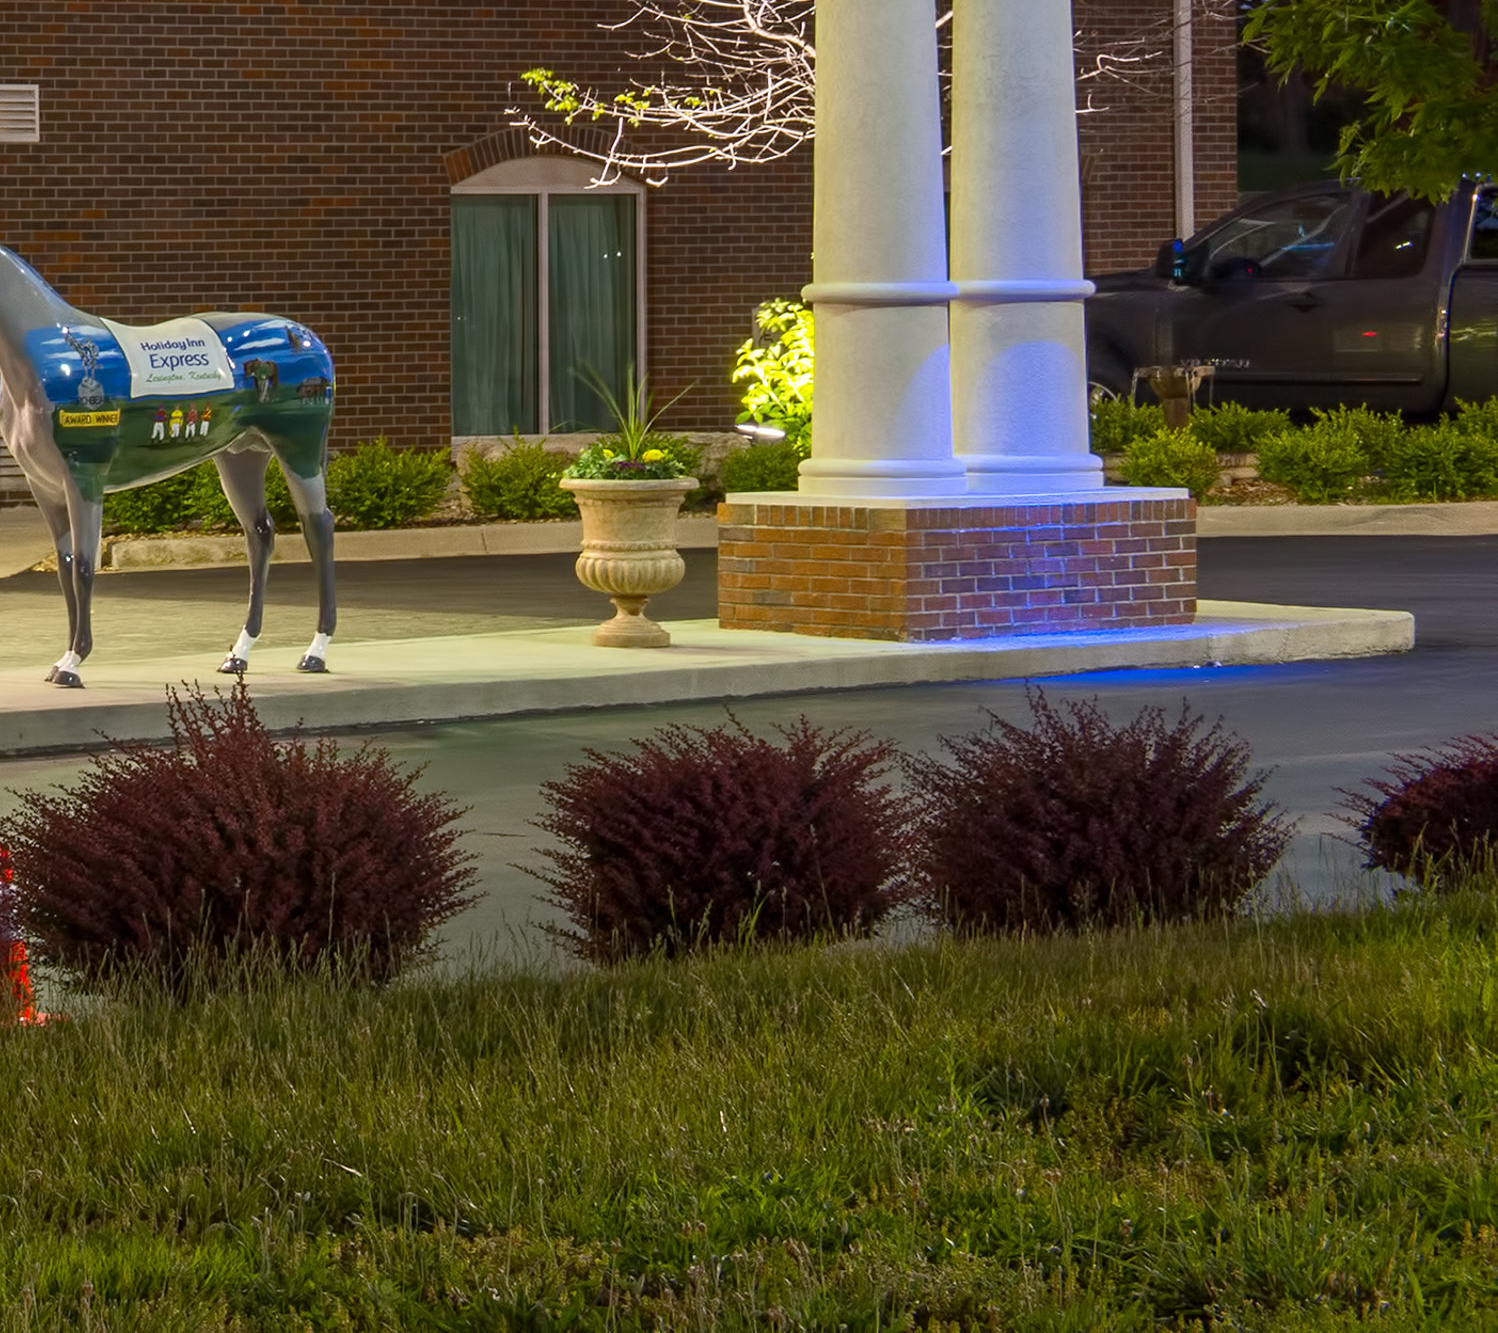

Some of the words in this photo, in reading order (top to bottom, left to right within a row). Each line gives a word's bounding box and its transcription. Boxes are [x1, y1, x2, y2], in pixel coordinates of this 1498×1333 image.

[140, 339, 187, 351] Holiday
[186, 338, 205, 348] Inn
[149, 353, 210, 371] Express
[64, 414, 92, 425] AWARD
